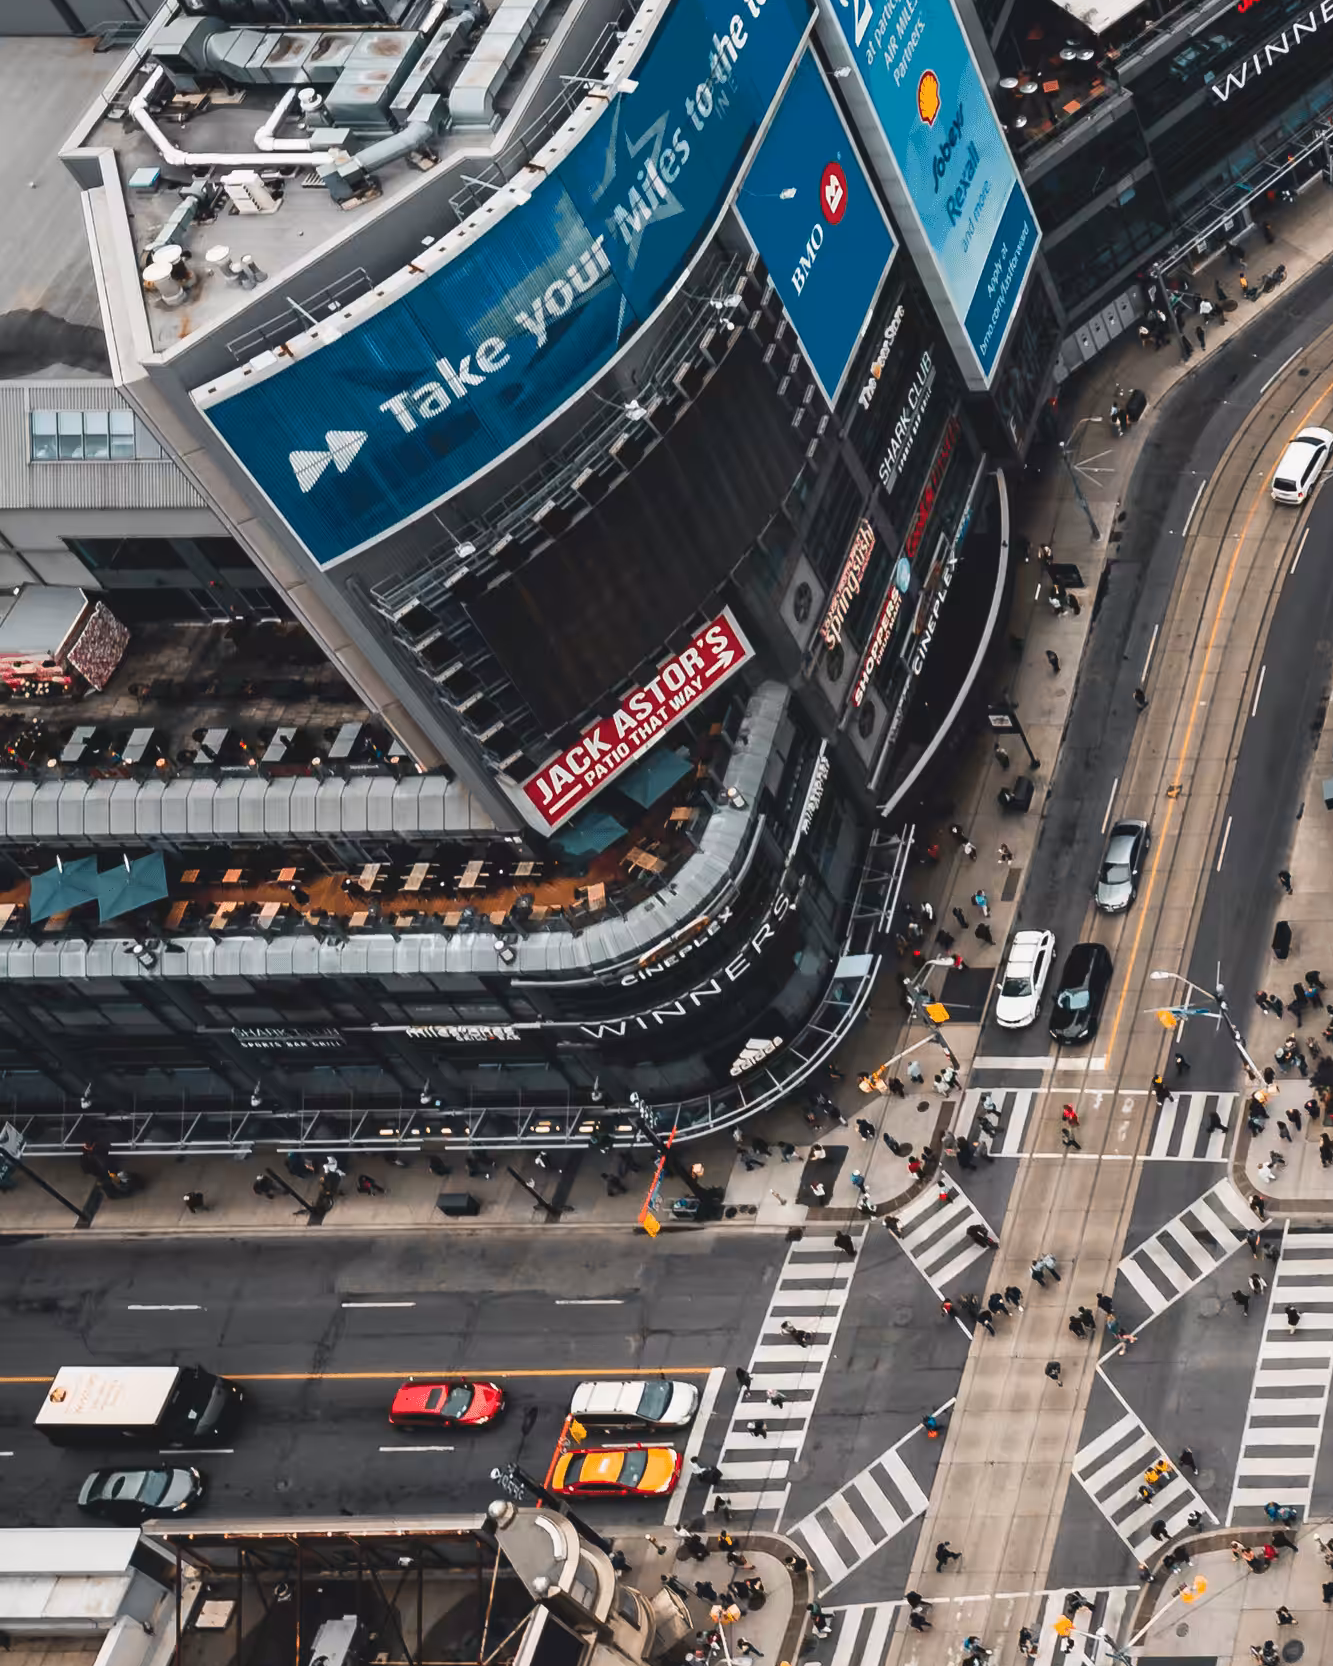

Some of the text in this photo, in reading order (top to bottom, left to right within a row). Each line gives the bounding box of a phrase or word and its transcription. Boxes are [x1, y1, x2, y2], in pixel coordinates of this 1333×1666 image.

[865, 40, 877, 65] at
[884, 31, 900, 70] AIR
[379, 336, 510, 434] Take
[516, 234, 612, 350] your
[611, 126, 691, 247] Miles
[685, 82, 715, 132] to
[709, 13, 748, 83] the
[946, 140, 980, 226] Rexall
[961, 179, 990, 253] and more
[791, 223, 824, 296] BMO
[987, 258, 1004, 298] Apply
[879, 350, 934, 486] SHARK CLUB
[853, 585, 900, 707] SHOPPERS
[912, 556, 959, 676] CINEPLEX
[536, 625, 728, 805] JACK ASTOR'S
[584, 675, 703, 787] PATIO THAT WAY
[580, 892, 790, 1038] WINNERS
[621, 906, 733, 987] CINEPLEX
